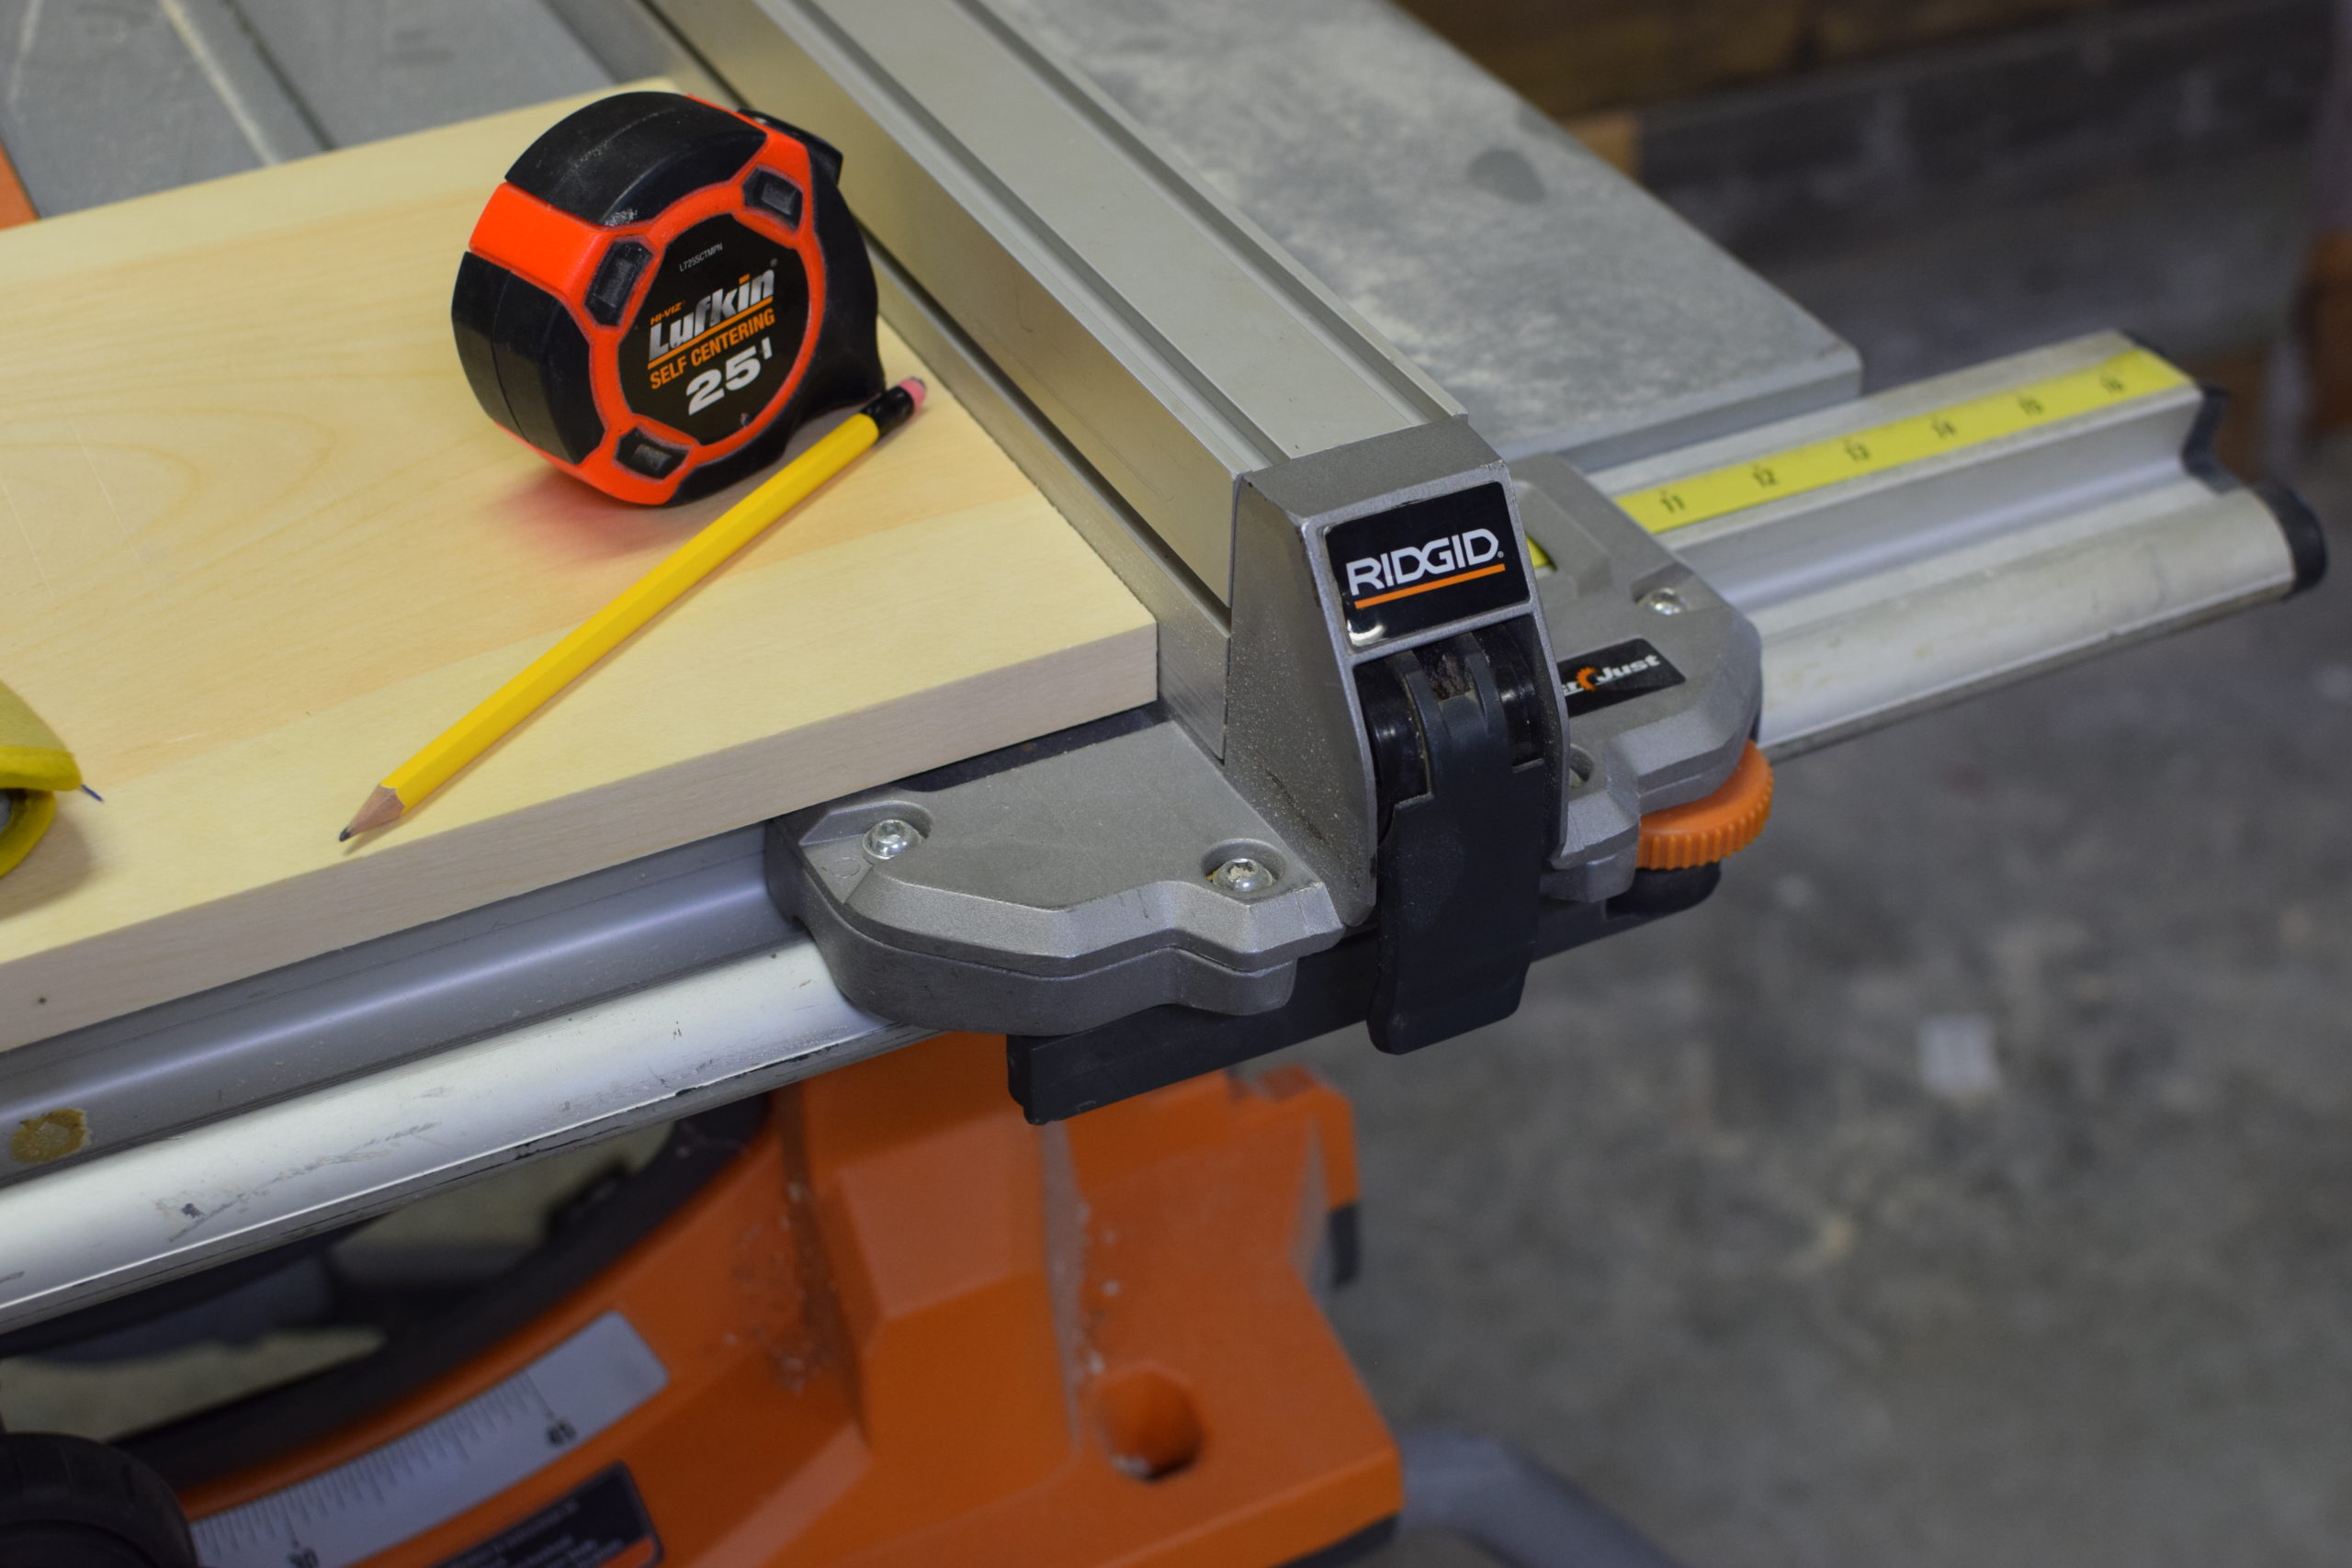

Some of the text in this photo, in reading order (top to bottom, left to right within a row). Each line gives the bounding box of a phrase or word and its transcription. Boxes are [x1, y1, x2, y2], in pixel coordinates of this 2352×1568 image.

[649, 268, 775, 362] Lufkin
[650, 308, 775, 389] SELF CENTERING
[1345, 527, 1499, 596] RIDGID
